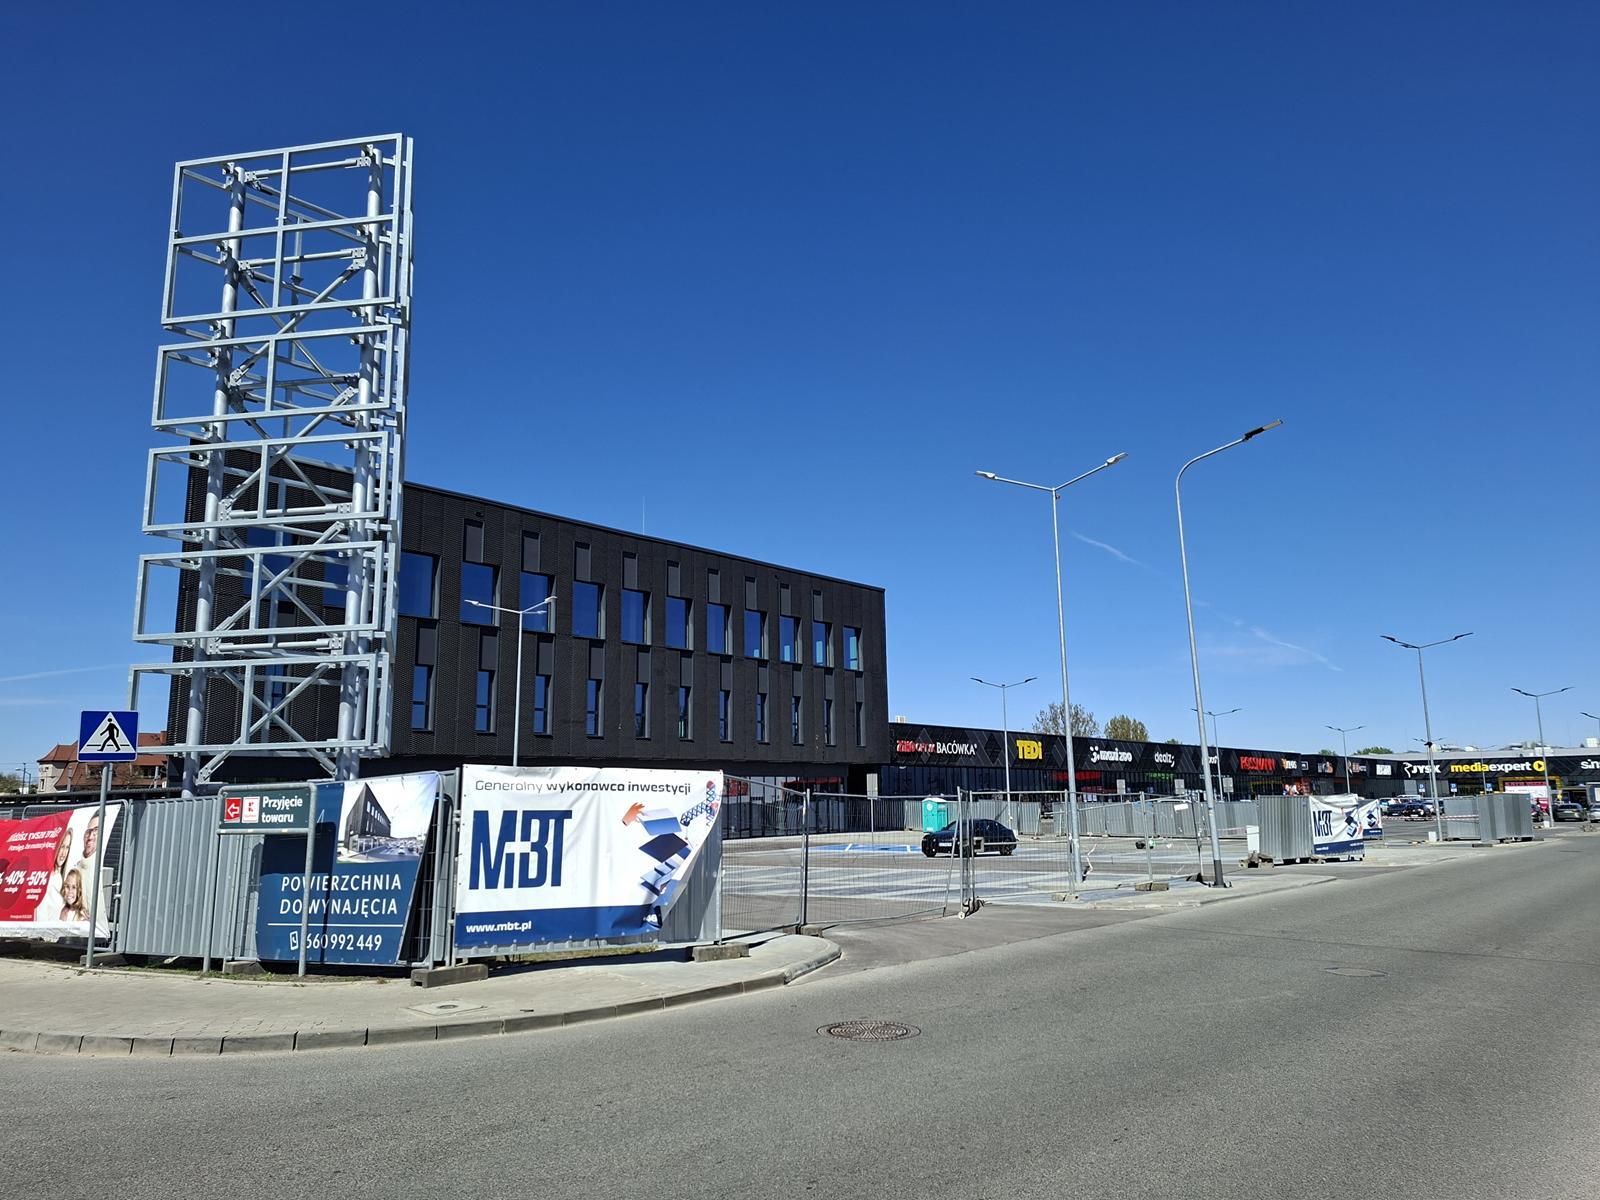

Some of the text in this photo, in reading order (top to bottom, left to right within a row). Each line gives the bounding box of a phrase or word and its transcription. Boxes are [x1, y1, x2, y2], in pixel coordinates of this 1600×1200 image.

[936, 740, 976, 755] BACÓWKA
[1016, 740, 1043, 760] TEDi
[1411, 764, 1442, 774] JYSK
[1450, 762, 1532, 774] mediaexpert
[1580, 758, 1600, 770] sin
[475, 780, 691, 796] Generalny wykonawca inwestycji
[262, 795, 303, 810] Przyjęcie
[261, 812, 294, 823] towaru
[469, 810, 572, 890] MBT
[5, 870, 27, 885] -40%
[27, 871, 49, 886] -50%
[465, 921, 532, 934] www.mbt.pl
